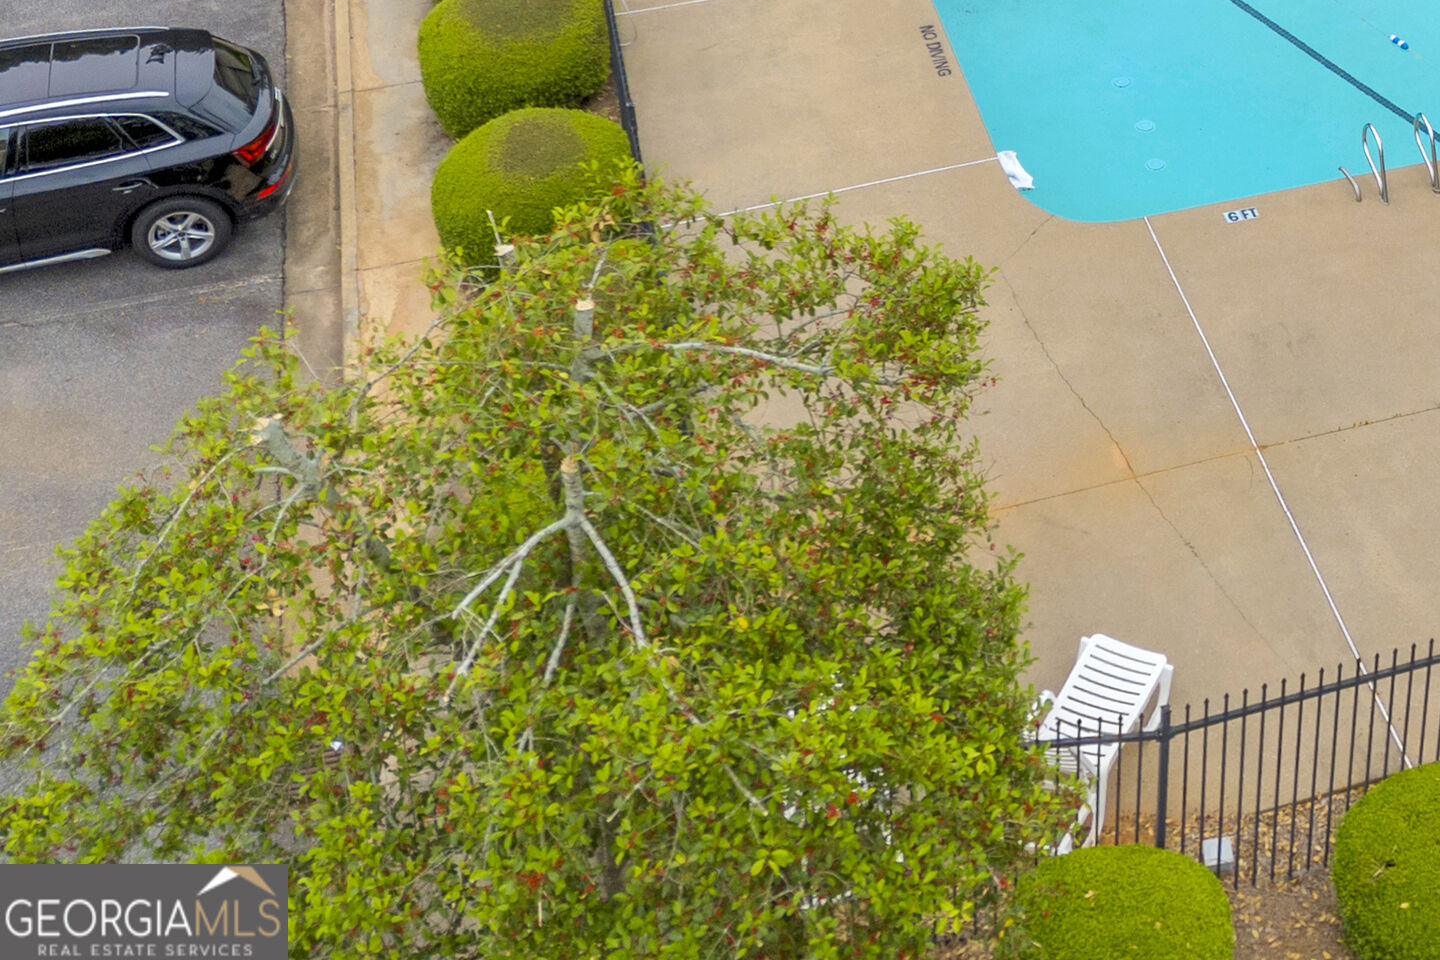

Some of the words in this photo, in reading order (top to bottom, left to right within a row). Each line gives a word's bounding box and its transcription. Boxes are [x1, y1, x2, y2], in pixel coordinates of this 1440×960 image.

[918, 24, 937, 41] NO
[926, 41, 952, 77] DIVING
[1227, 211, 1239, 222] 6
[1240, 207, 1257, 220] FT
